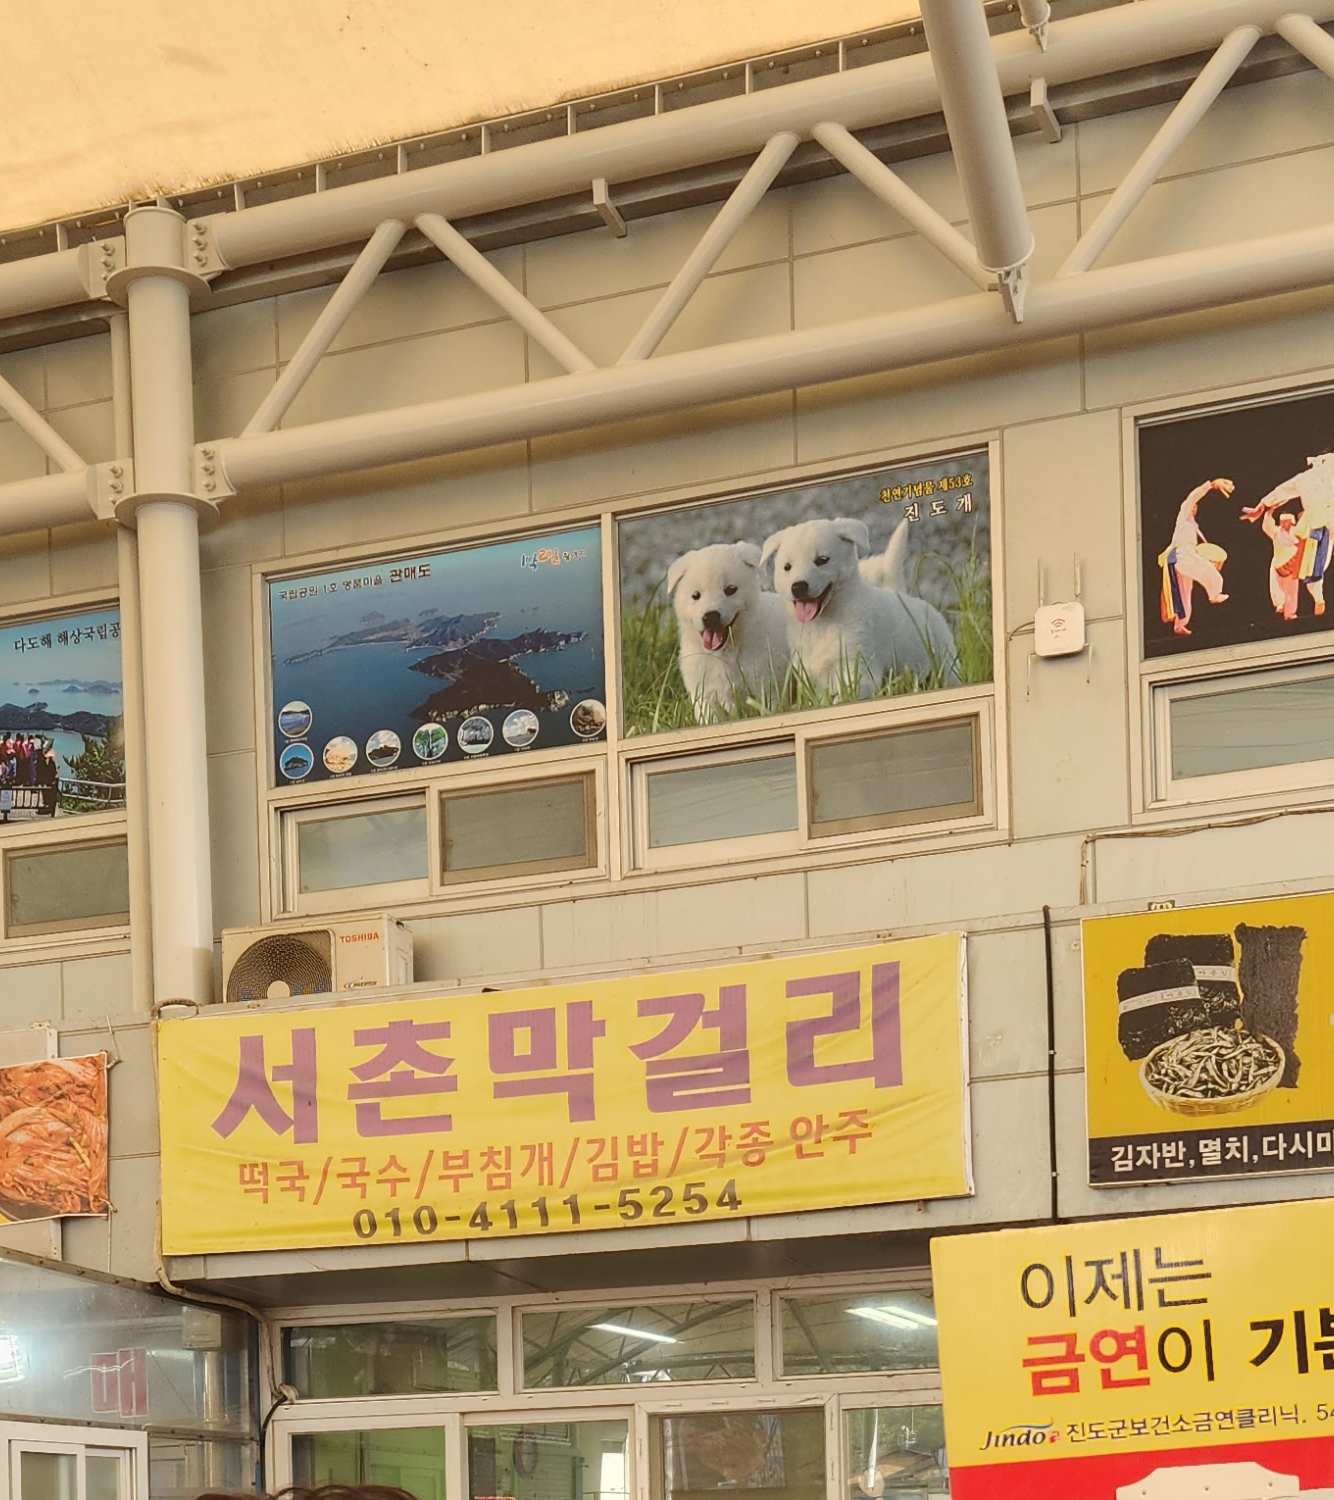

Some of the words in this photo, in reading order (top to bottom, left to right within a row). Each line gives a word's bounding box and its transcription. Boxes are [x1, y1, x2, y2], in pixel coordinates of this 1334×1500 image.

[937, 473, 973, 492] 제53호
[389, 563, 431, 583] 관매도
[14, 633, 52, 653] 다도해
[339, 932, 380, 944] TOSHIBA
[211, 960, 904, 1146] 서촌막걸리
[789, 1108, 875, 1160] 안주
[352, 1178, 742, 1241] 010-4111-5254
[1020, 1246, 1213, 1318] 이제는
[1022, 1319, 1215, 1397] 금연이
[979, 1425, 1048, 1451] Jindo
[1066, 1404, 1307, 1445] 진도군보건소금연클리닉.
